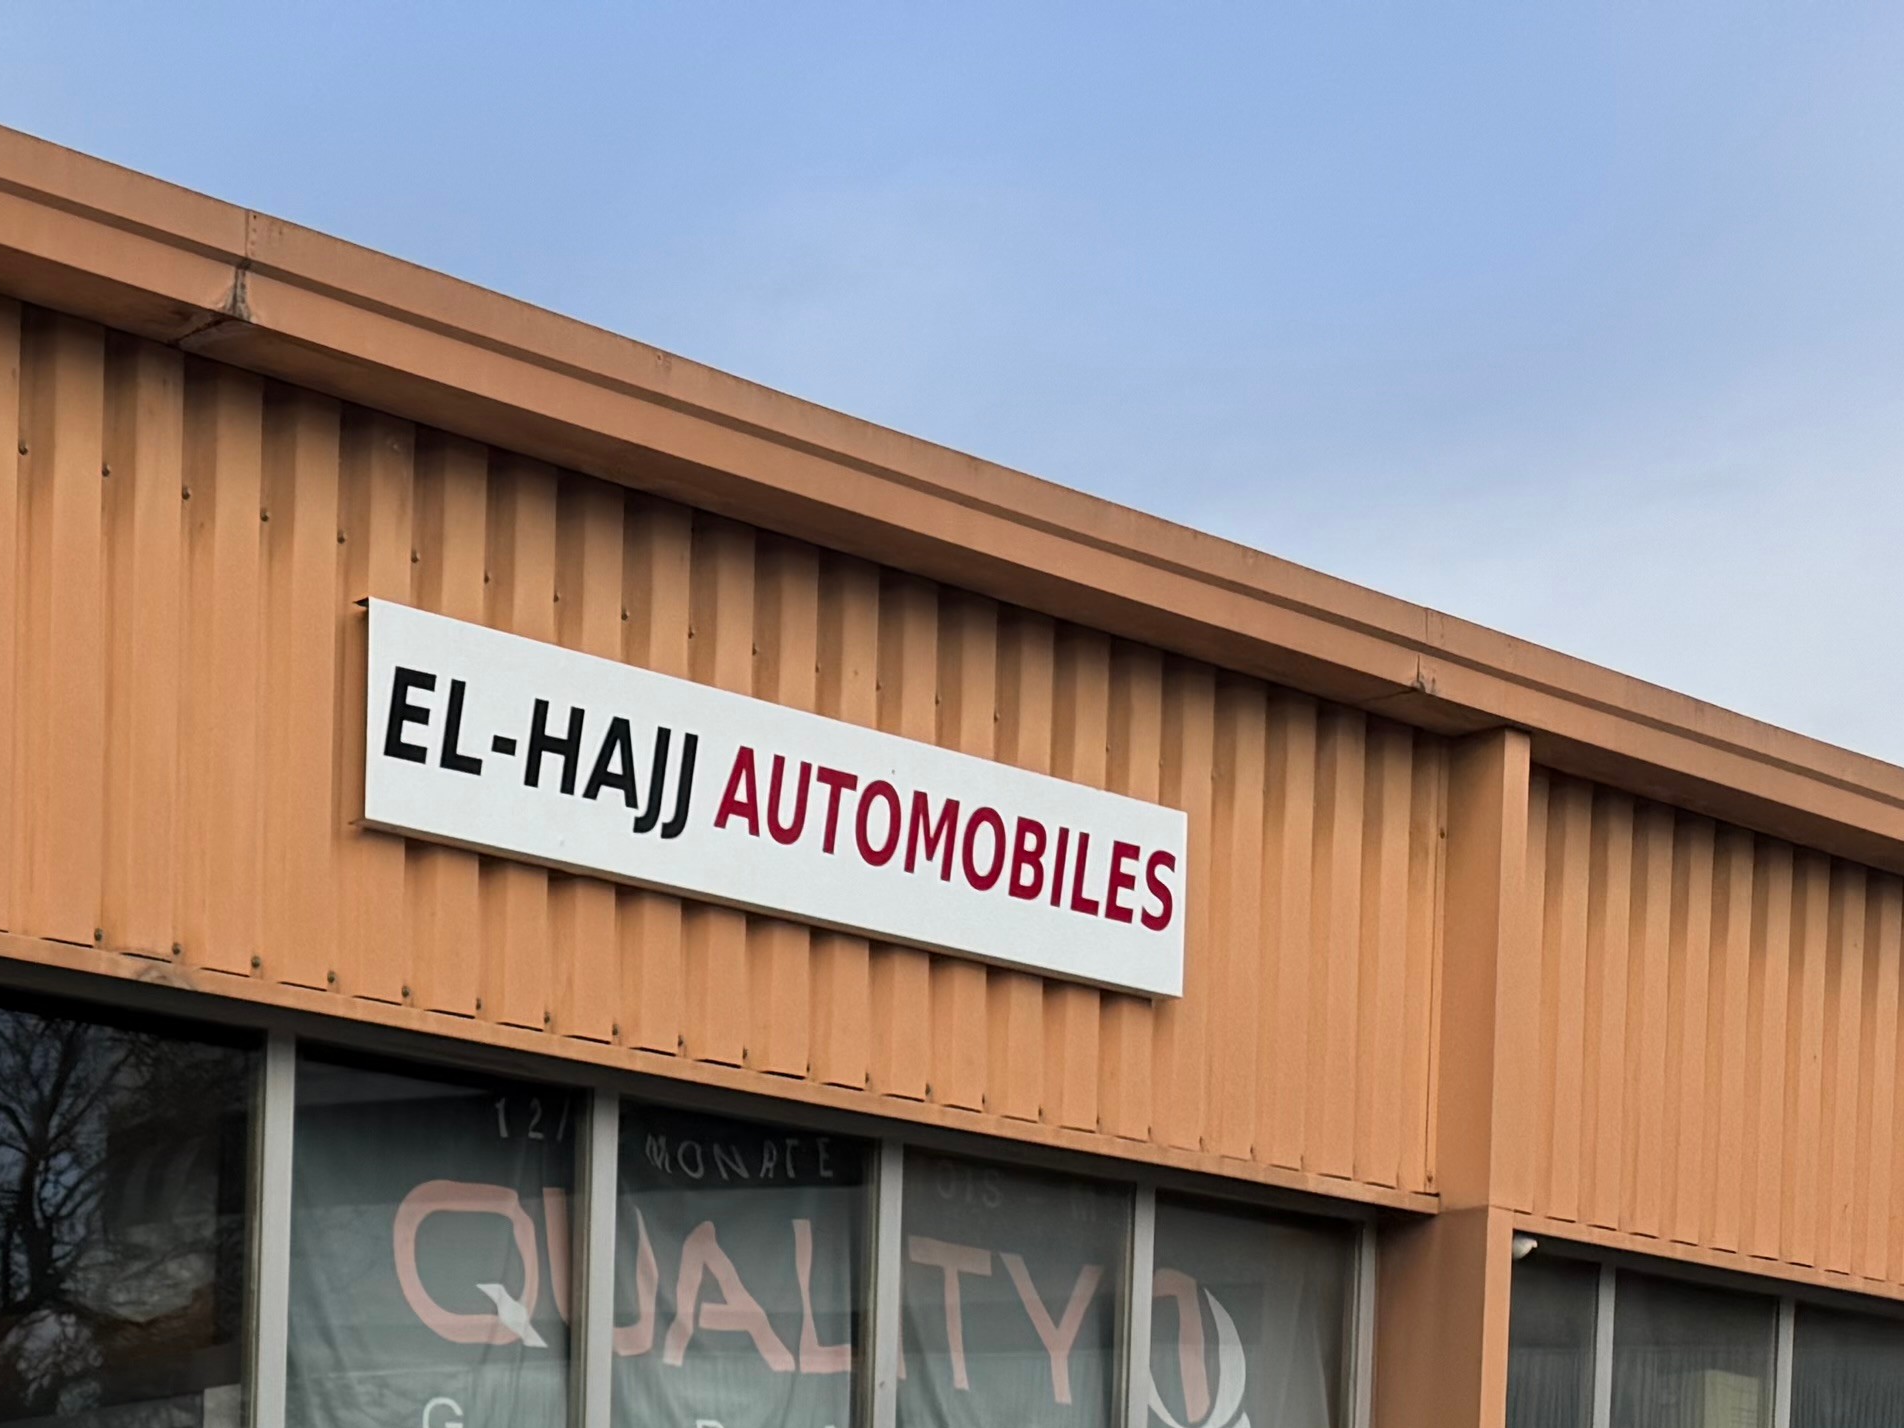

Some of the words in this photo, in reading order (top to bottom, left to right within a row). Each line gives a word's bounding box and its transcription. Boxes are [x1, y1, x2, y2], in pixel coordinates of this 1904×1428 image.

[383, 666, 699, 840] EL-HAJJ
[713, 745, 1176, 932] AUTOMOBILES
[393, 1180, 1104, 1405] QUALTY
